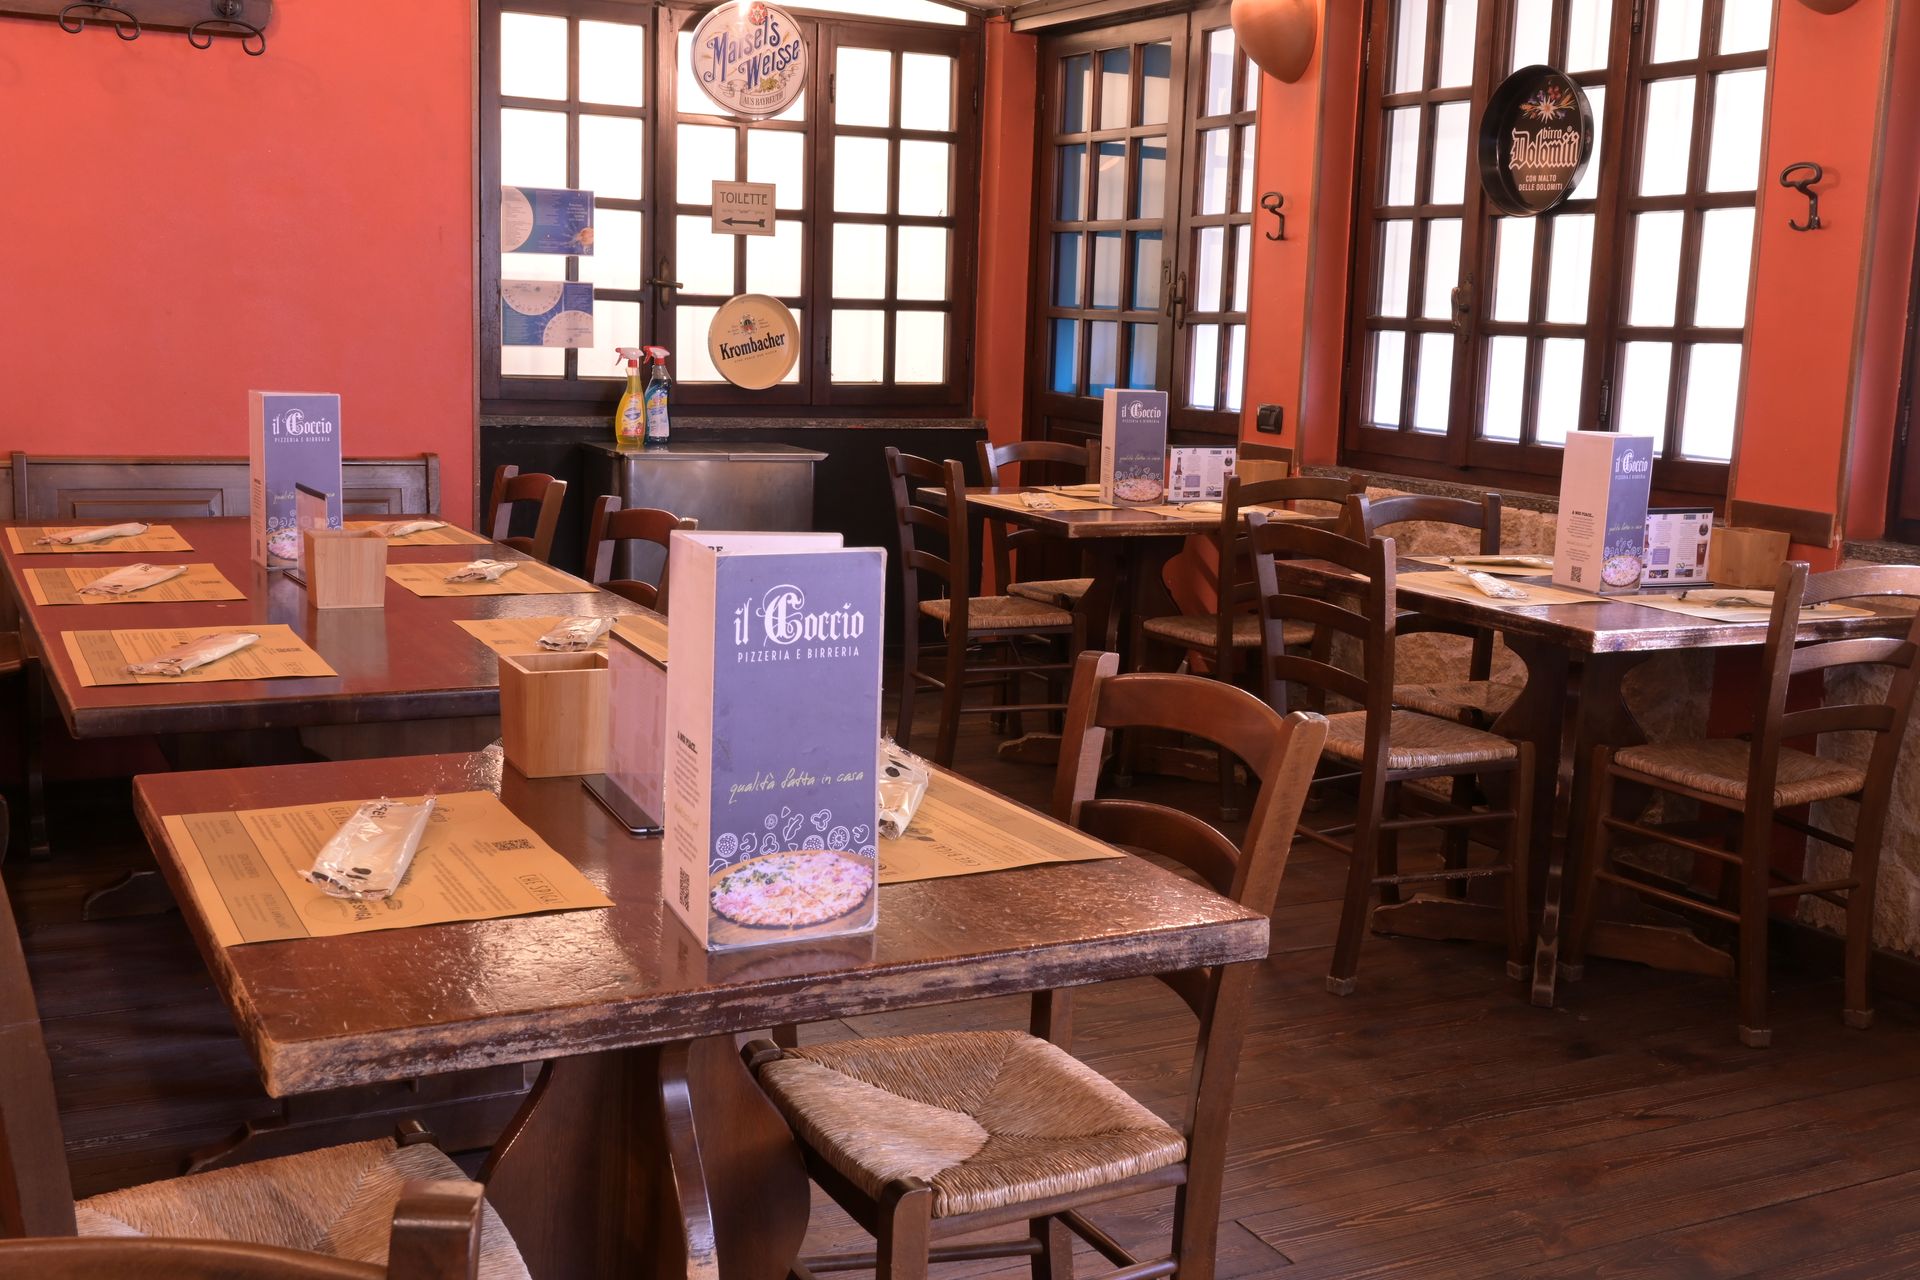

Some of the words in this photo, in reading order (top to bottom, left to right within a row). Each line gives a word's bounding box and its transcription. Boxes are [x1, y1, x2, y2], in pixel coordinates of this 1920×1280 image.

[738, 39, 800, 90] Weisse
[1518, 183, 1536, 191] DELLE
[1536, 183, 1563, 191] DOLOMITI
[1525, 174, 1537, 183] CON
[1538, 174, 1557, 183] MALTO
[720, 191, 769, 206] TOILETTE
[719, 331, 785, 361] Krombacher
[272, 413, 281, 436] il
[733, 597, 752, 646] il
[737, 649, 791, 663] PIZZERIA
[796, 648, 801, 660] E
[807, 645, 860, 659] BIRRERIA
[728, 771, 777, 805] qualità
[780, 767, 817, 789] fatta
[821, 774, 832, 785] in
[836, 771, 864, 783] casa
